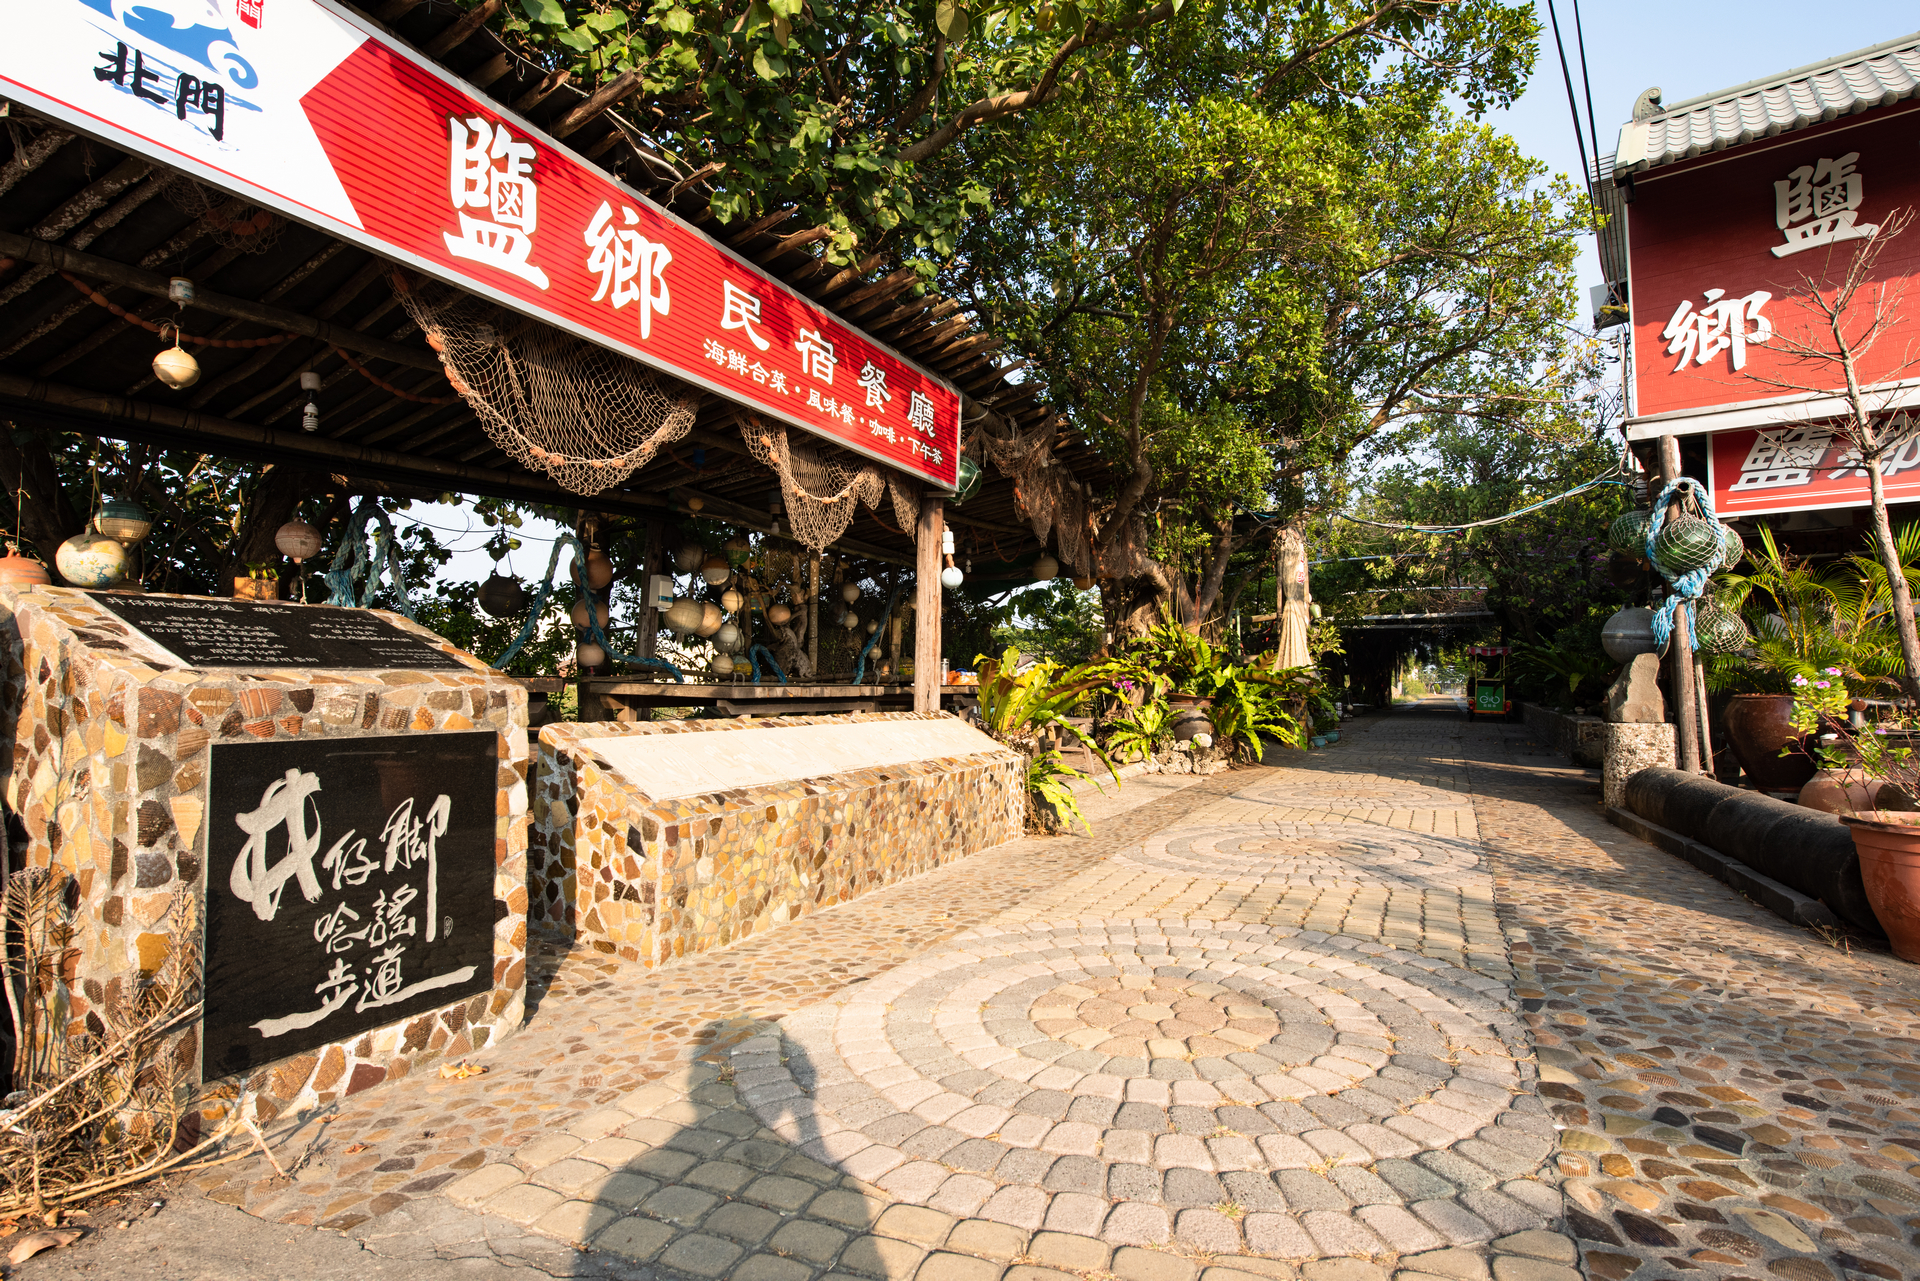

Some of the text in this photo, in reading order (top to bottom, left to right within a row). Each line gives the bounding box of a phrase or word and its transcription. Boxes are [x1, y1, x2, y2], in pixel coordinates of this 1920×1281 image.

[94, 42, 225, 141] 北門
[1771, 152, 1879, 258] 鹽
[442, 115, 937, 439] 鹽鄉 民宿餐廳
[1663, 288, 1773, 372] 鄉
